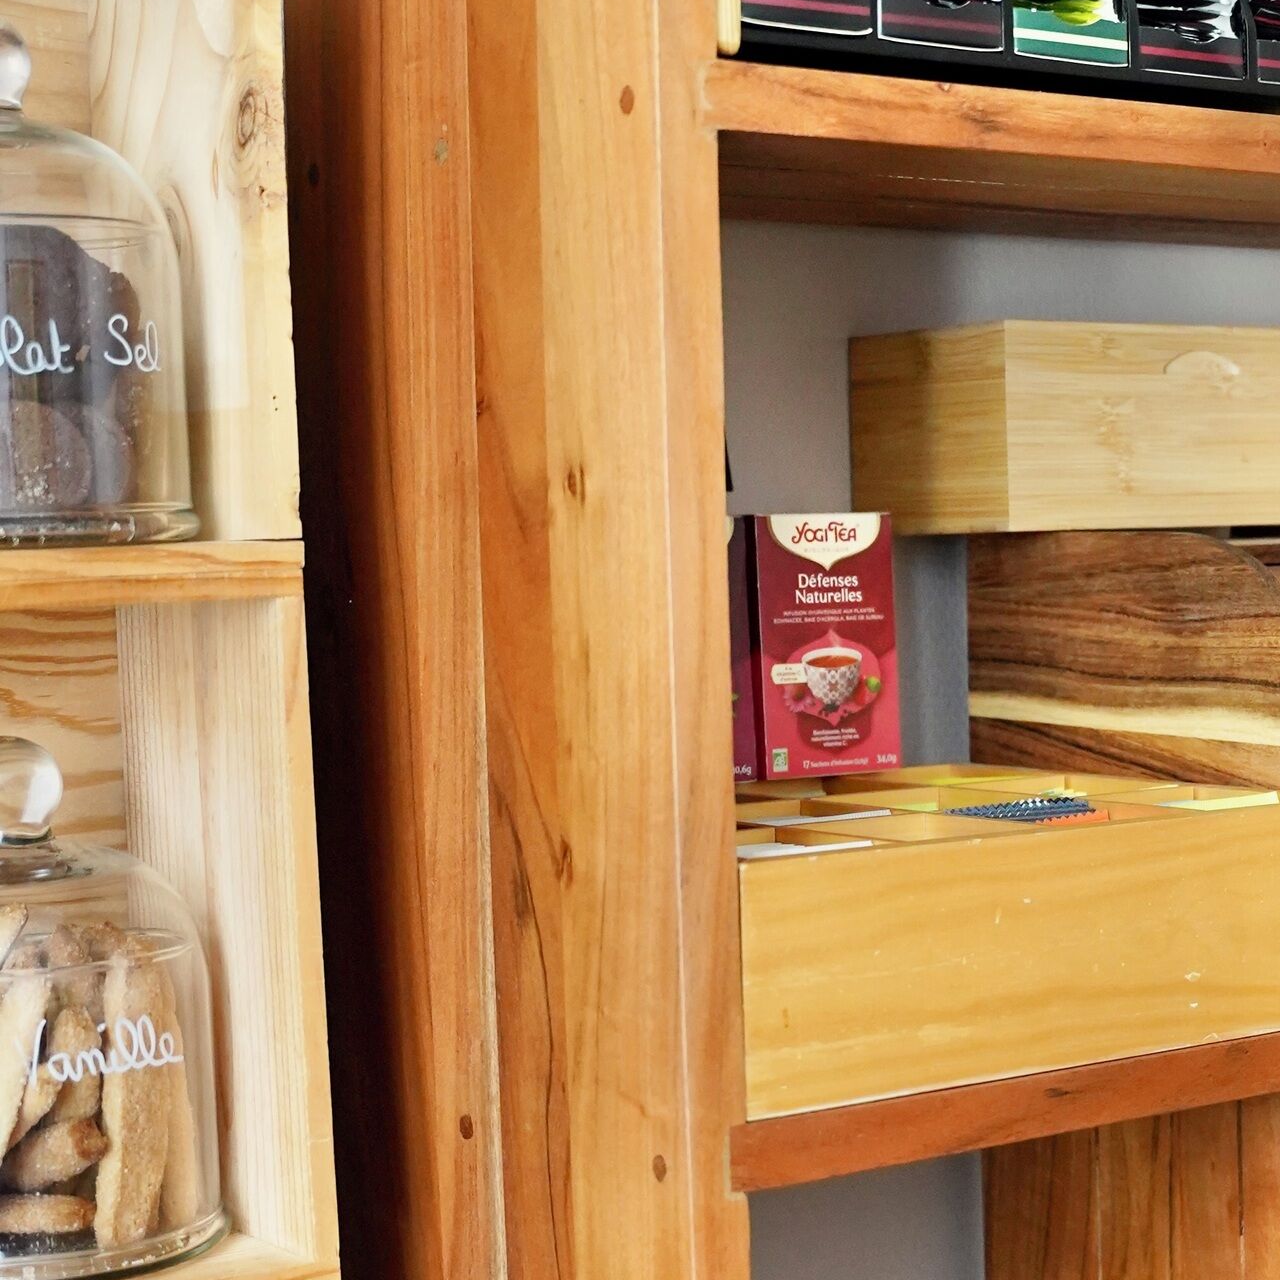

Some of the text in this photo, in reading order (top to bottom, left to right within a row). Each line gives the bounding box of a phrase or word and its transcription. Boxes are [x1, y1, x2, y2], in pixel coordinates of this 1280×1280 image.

[104, 314, 161, 372] Sel
[791, 521, 828, 544] YOGI
[798, 573, 859, 589] Défenses
[795, 588, 863, 604] Naturelles
[26, 1014, 184, 1089] Vanille
